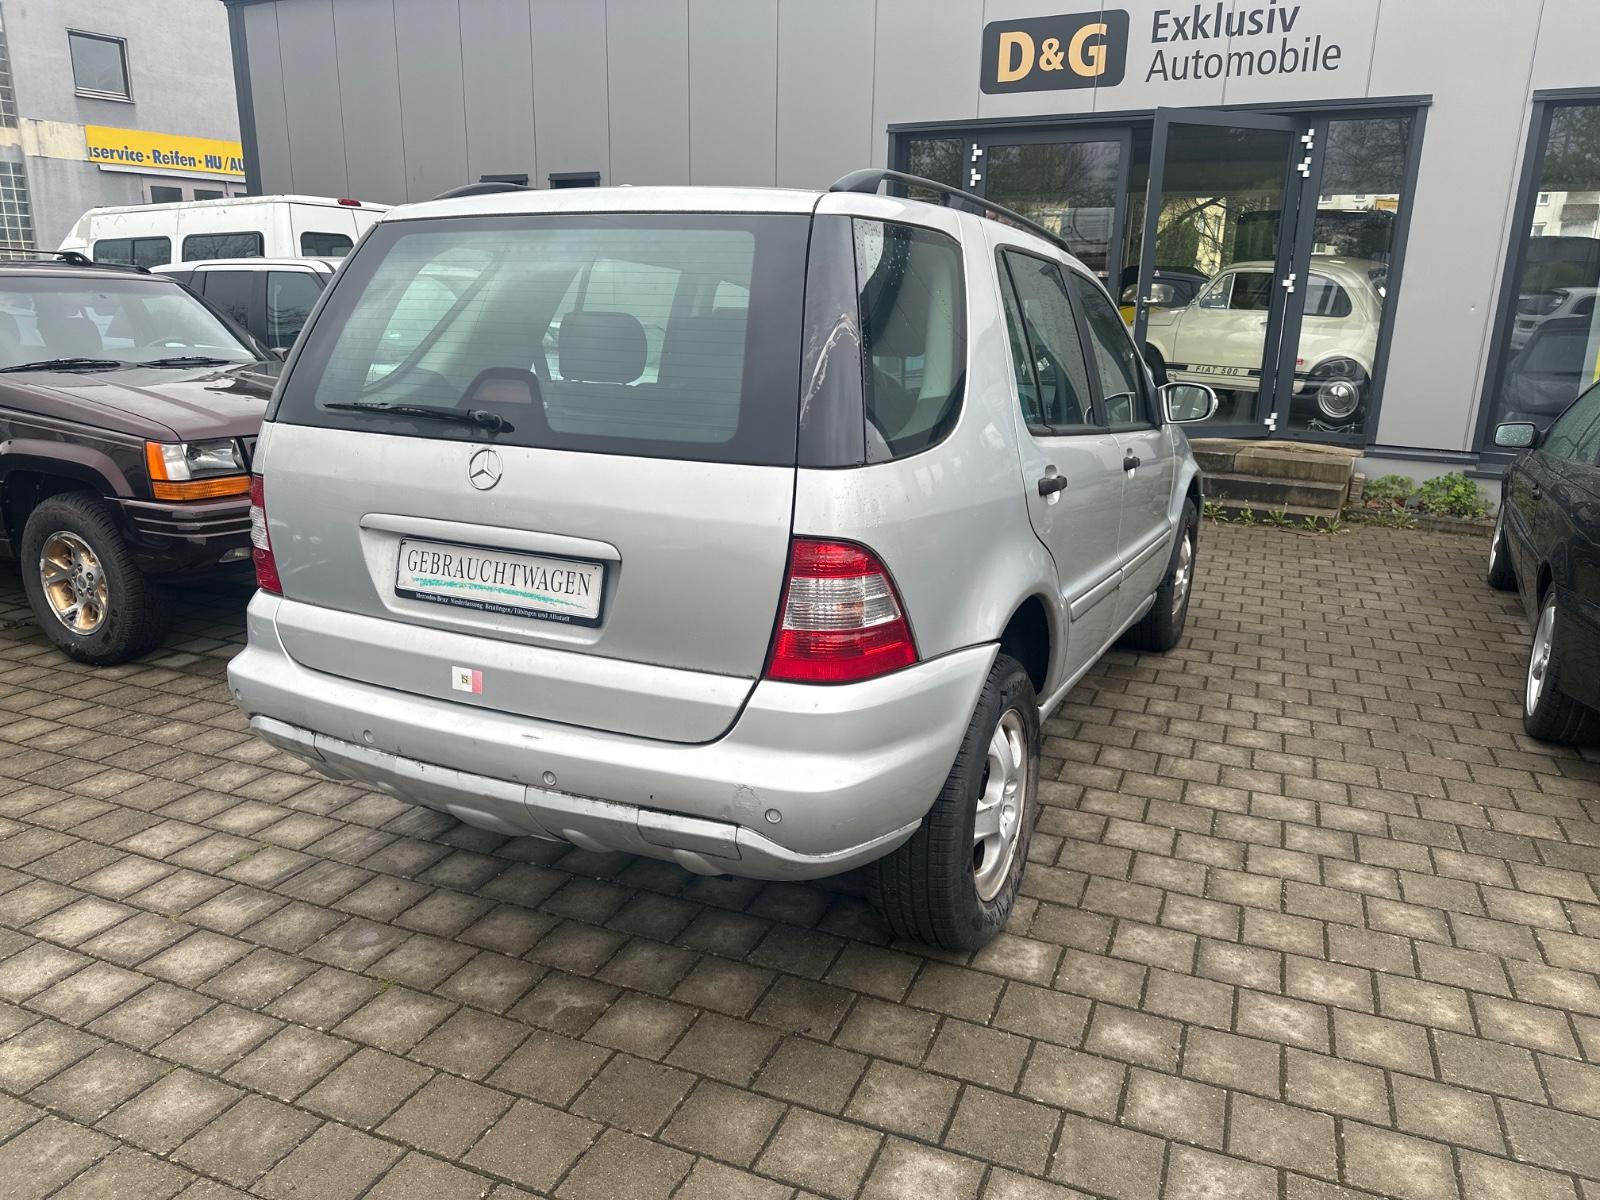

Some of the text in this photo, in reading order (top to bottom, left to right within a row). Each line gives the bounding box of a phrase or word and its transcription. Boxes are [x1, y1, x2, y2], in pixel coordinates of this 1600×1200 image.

[1151, 0, 1301, 43] Exklusiv
[997, 23, 1108, 83] D&G
[1145, 35, 1342, 83] Automobile
[152, 149, 196, 167] Reifen
[407, 549, 592, 597] GEBRAUCHTWAGEN
